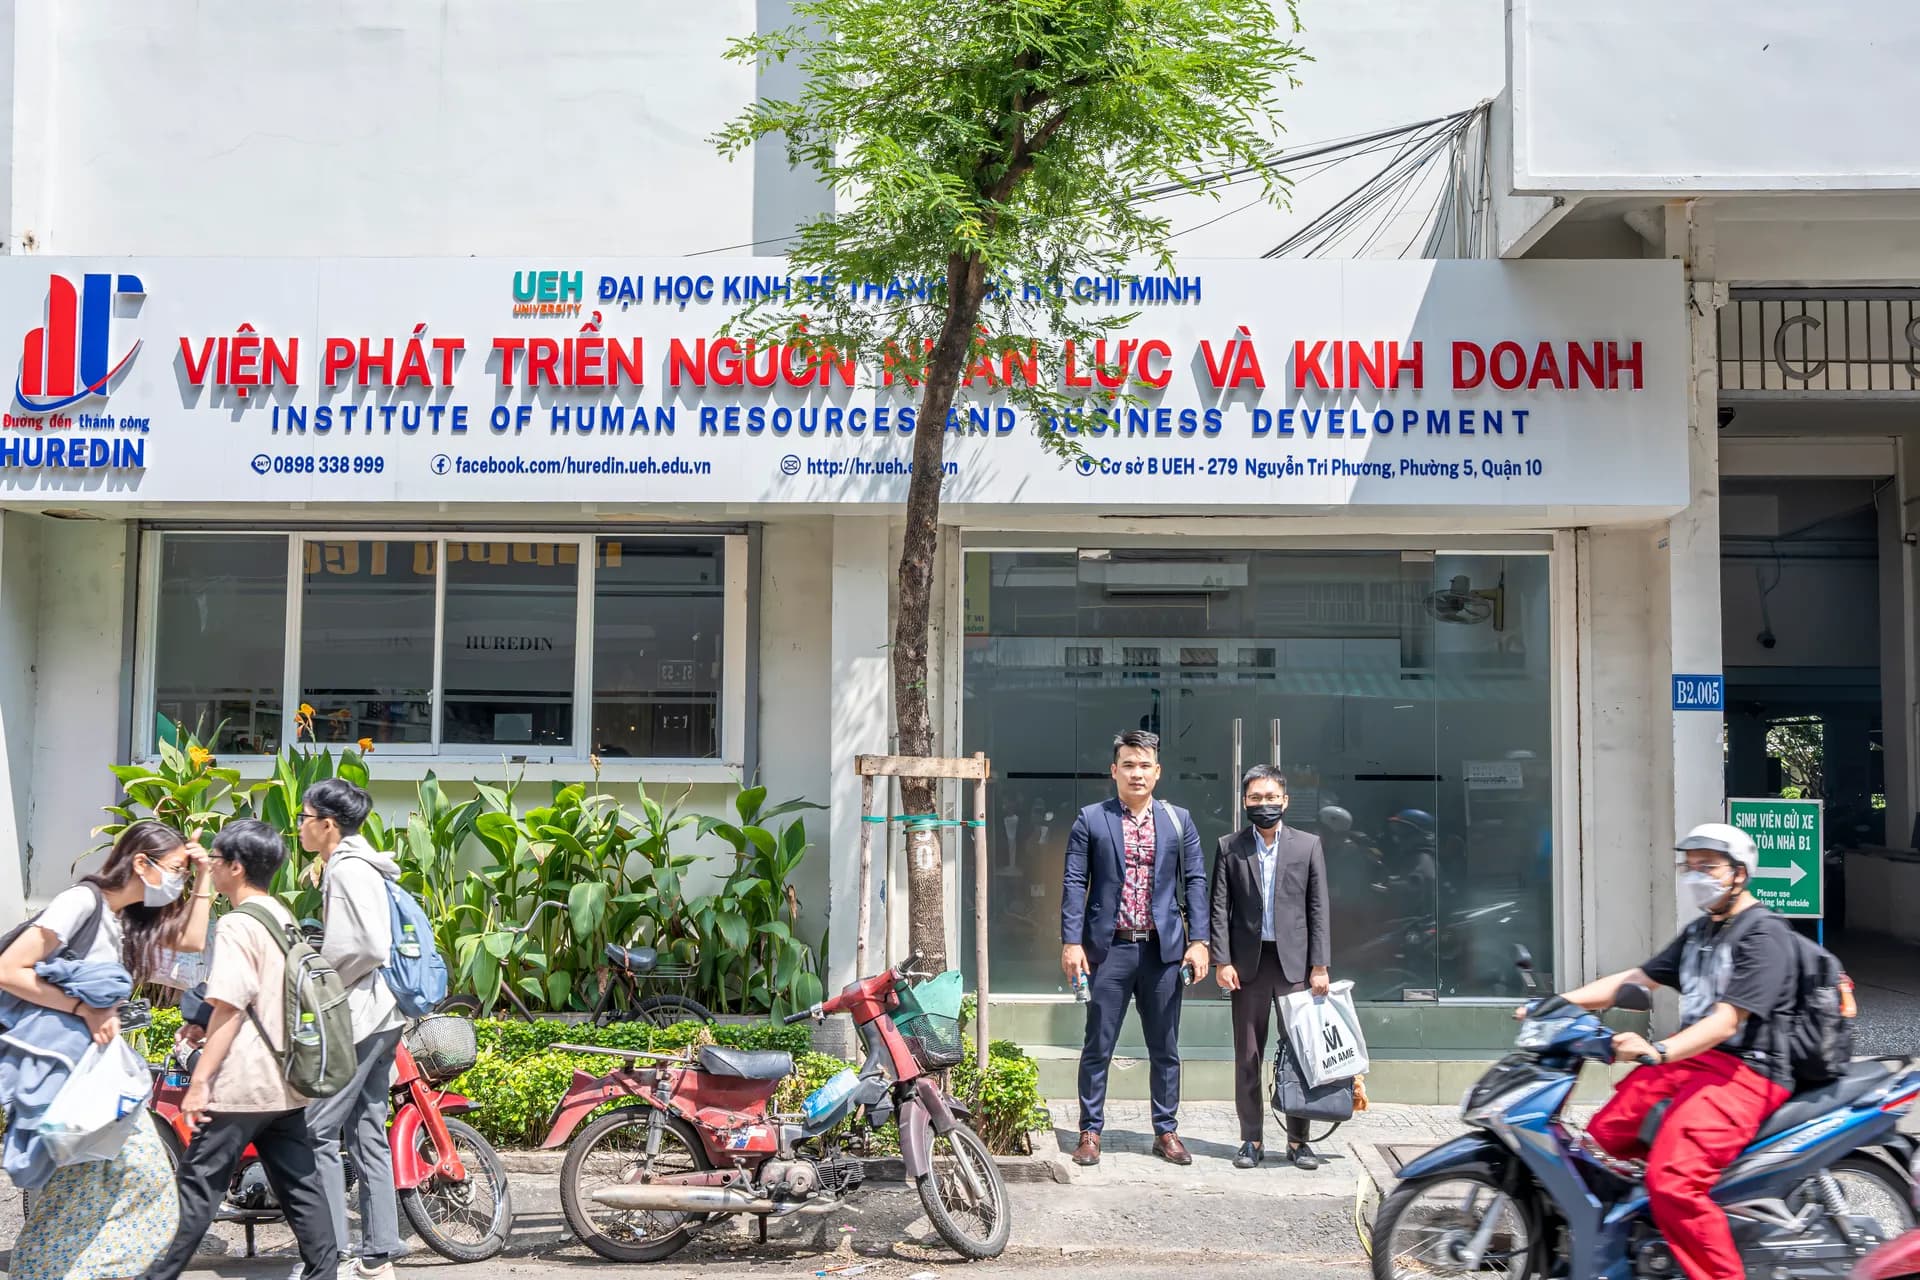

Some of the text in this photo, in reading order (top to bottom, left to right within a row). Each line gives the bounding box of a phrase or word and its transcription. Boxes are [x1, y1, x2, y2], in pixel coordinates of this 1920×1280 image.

[513, 270, 583, 300] UEH
[598, 276, 643, 308] ĐẠI
[655, 275, 714, 309] HỌC
[724, 276, 791, 300] KINH
[1131, 276, 1202, 301] MINH
[513, 304, 582, 314] UNIVERSITY
[179, 323, 299, 397] VIỆN
[325, 323, 465, 387] PHÁT
[492, 311, 643, 387] TRIỂN
[1065, 338, 1173, 399] LỰC
[1200, 326, 1266, 389] VÀ
[1293, 340, 1423, 390] KINH
[1451, 341, 1643, 391] DOANH
[272, 405, 468, 432] INSTITUTE
[490, 405, 532, 431] OF
[551, 406, 676, 431] HUMAN
[700, 407, 915, 432] RESOURCES
[1253, 408, 1529, 434] DEVELOPMENT
[0, 437, 145, 467] HUREDIN
[274, 456, 384, 474] 0898 338 999
[456, 456, 711, 475] facebook.com/huredin.ueh.edu.vn
[1100, 457, 1121, 475] Cơ
[1125, 456, 1144, 475] sở
[1148, 458, 1158, 475] B
[1162, 458, 1195, 475] UEH
[1208, 458, 1238, 475] 279
[1245, 455, 1303, 479] Nguyễn
[1307, 459, 1327, 476] Tri
[1331, 459, 1395, 480] Phương,
[1399, 458, 1460, 480] Phường
[1463, 459, 1477, 478] 5,
[1481, 459, 1522, 480] Quận
[1525, 459, 1542, 476] 10
[465, 635, 553, 651] HUREDIN
[1677, 680, 1719, 704] B2.005
[1736, 808, 1814, 830] SINH VIÊN GỬI XE
[1756, 830, 1774, 849] TÒA
[1777, 832, 1796, 850] NHÀ
[1799, 835, 1811, 850] B1
[1757, 888, 1778, 898] Please
[1777, 898, 1785, 907] lot
[1786, 898, 1810, 907] outside
